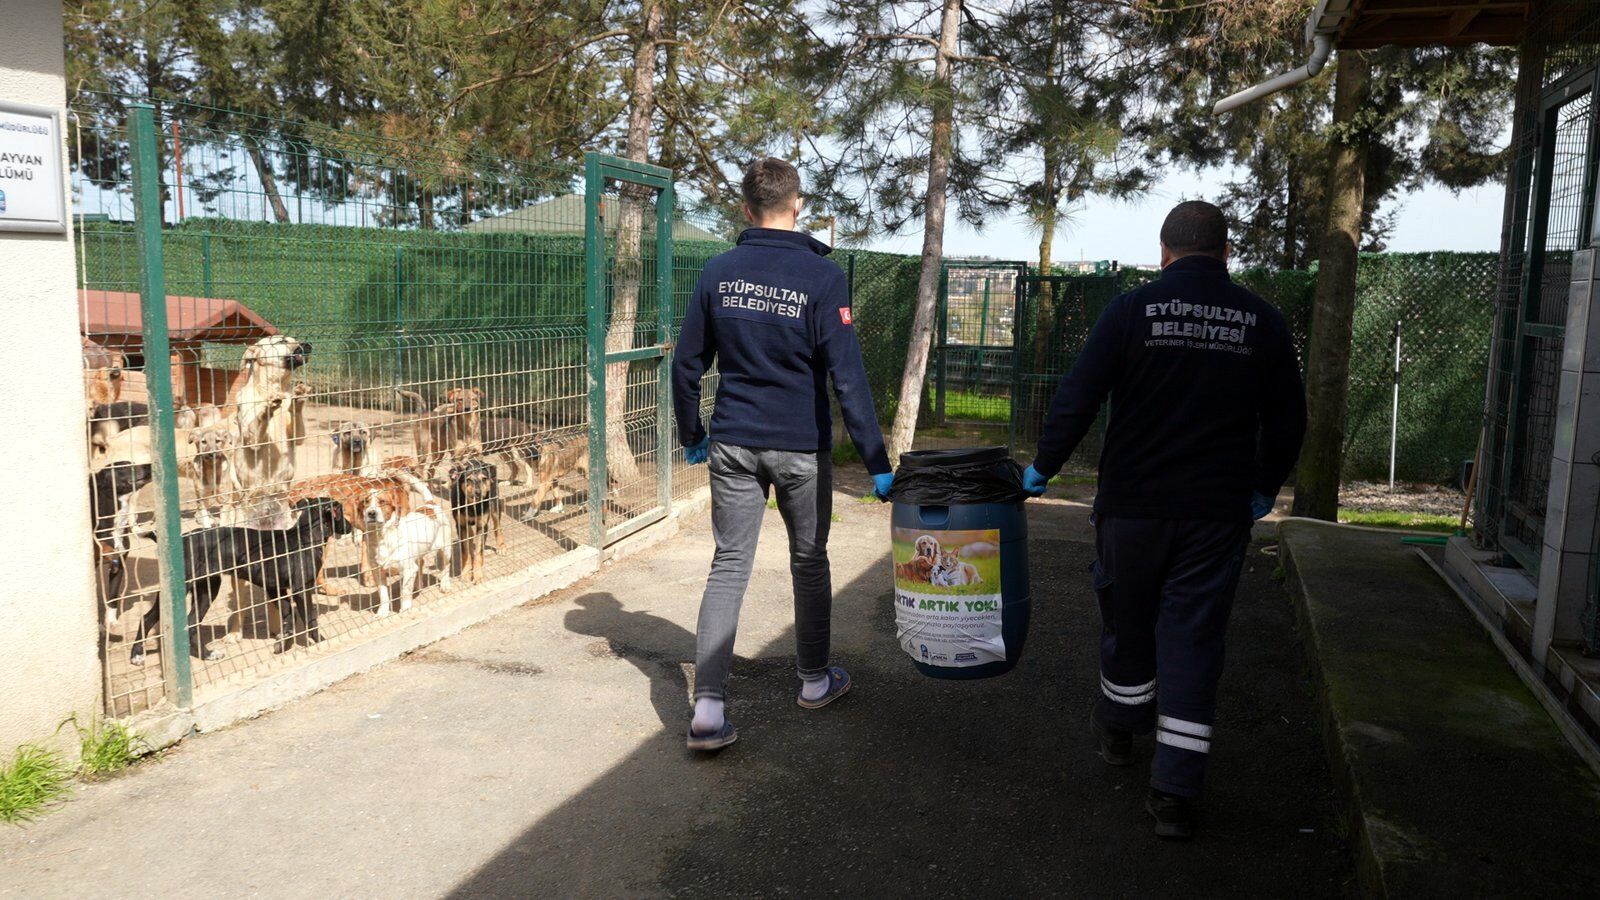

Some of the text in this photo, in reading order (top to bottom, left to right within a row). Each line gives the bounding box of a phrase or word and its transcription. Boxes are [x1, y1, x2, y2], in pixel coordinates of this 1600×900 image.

[718, 279, 808, 305] EYÜPSULTAN
[722, 295, 801, 319] BELEDİYESİ
[1145, 298, 1257, 327] EYÜPSULTAN
[1151, 320, 1246, 343] BELEDİYESİ
[918, 599, 959, 613] ARTIK
[964, 599, 998, 613] YOK!
